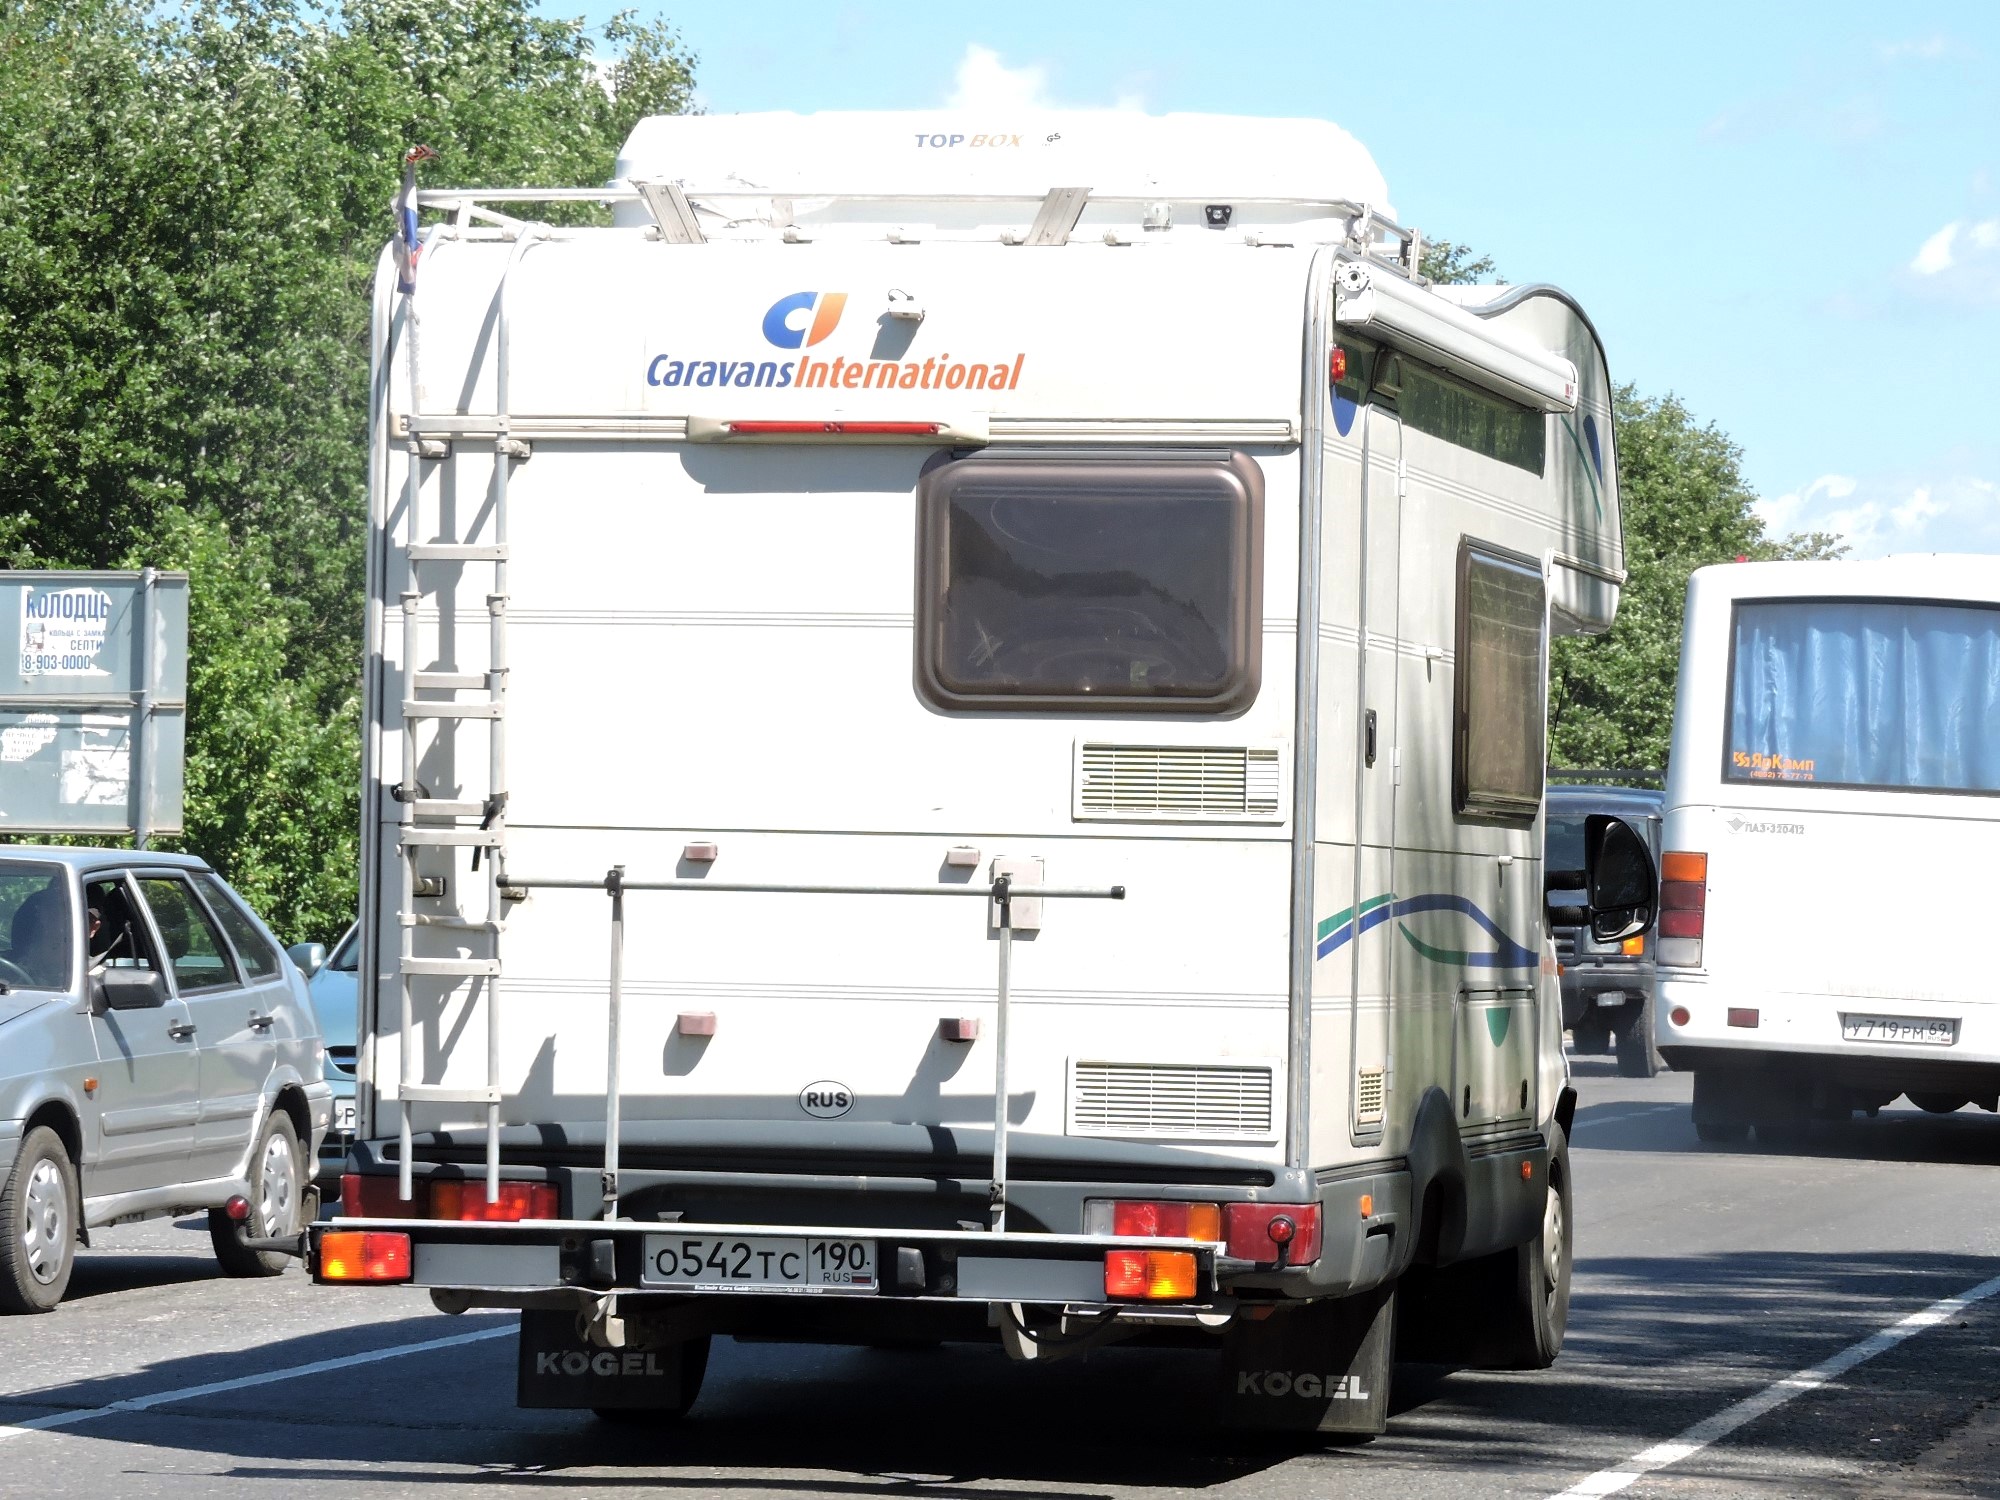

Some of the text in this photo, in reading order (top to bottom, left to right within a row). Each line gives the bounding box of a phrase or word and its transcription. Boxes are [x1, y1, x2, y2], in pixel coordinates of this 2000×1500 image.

[915, 134, 1024, 148] TOP BOX
[1929, 1022, 1947, 1036] 69
[806, 1092, 848, 1108] RUS
[812, 1242, 865, 1270] 190
[823, 1272, 850, 1282] RUS
[537, 1350, 663, 1376] KÖGEL
[1237, 1370, 1369, 1400] KÖGEL
